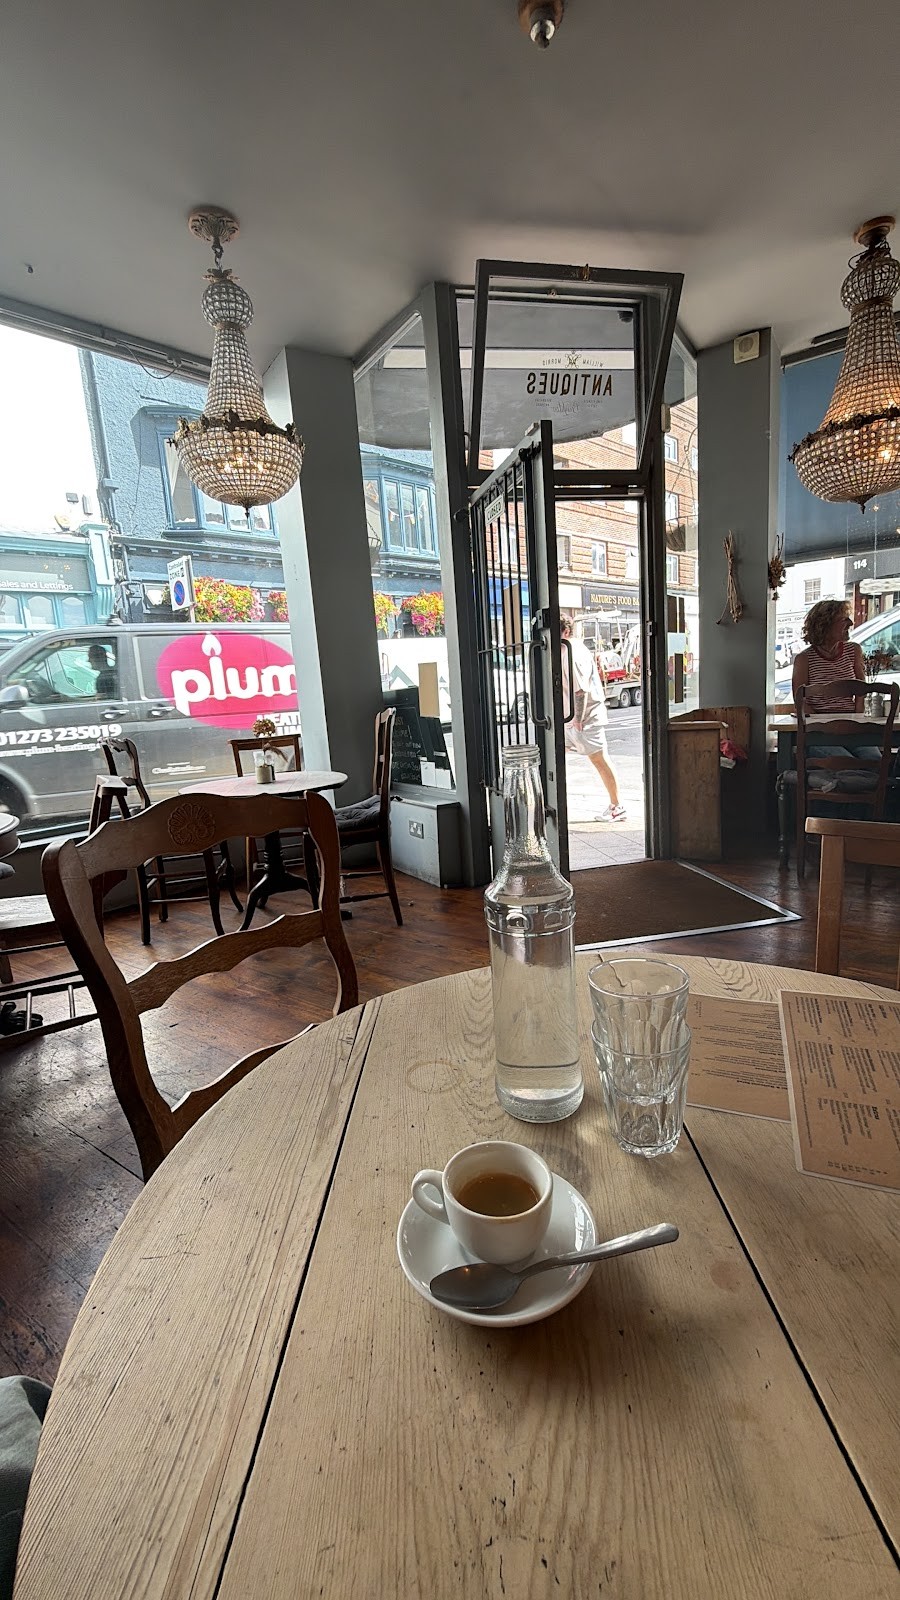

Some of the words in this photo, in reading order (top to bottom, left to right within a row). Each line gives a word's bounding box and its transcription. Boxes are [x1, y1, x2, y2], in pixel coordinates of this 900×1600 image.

[853, 559, 867, 570] 114
[20, 581, 38, 589] and
[40, 581, 74, 591] Lettings
[617, 595, 632, 606] FOOD
[171, 656, 298, 716] plum
[0, 729, 53, 746] 01273
[55, 723, 123, 741] 235019
